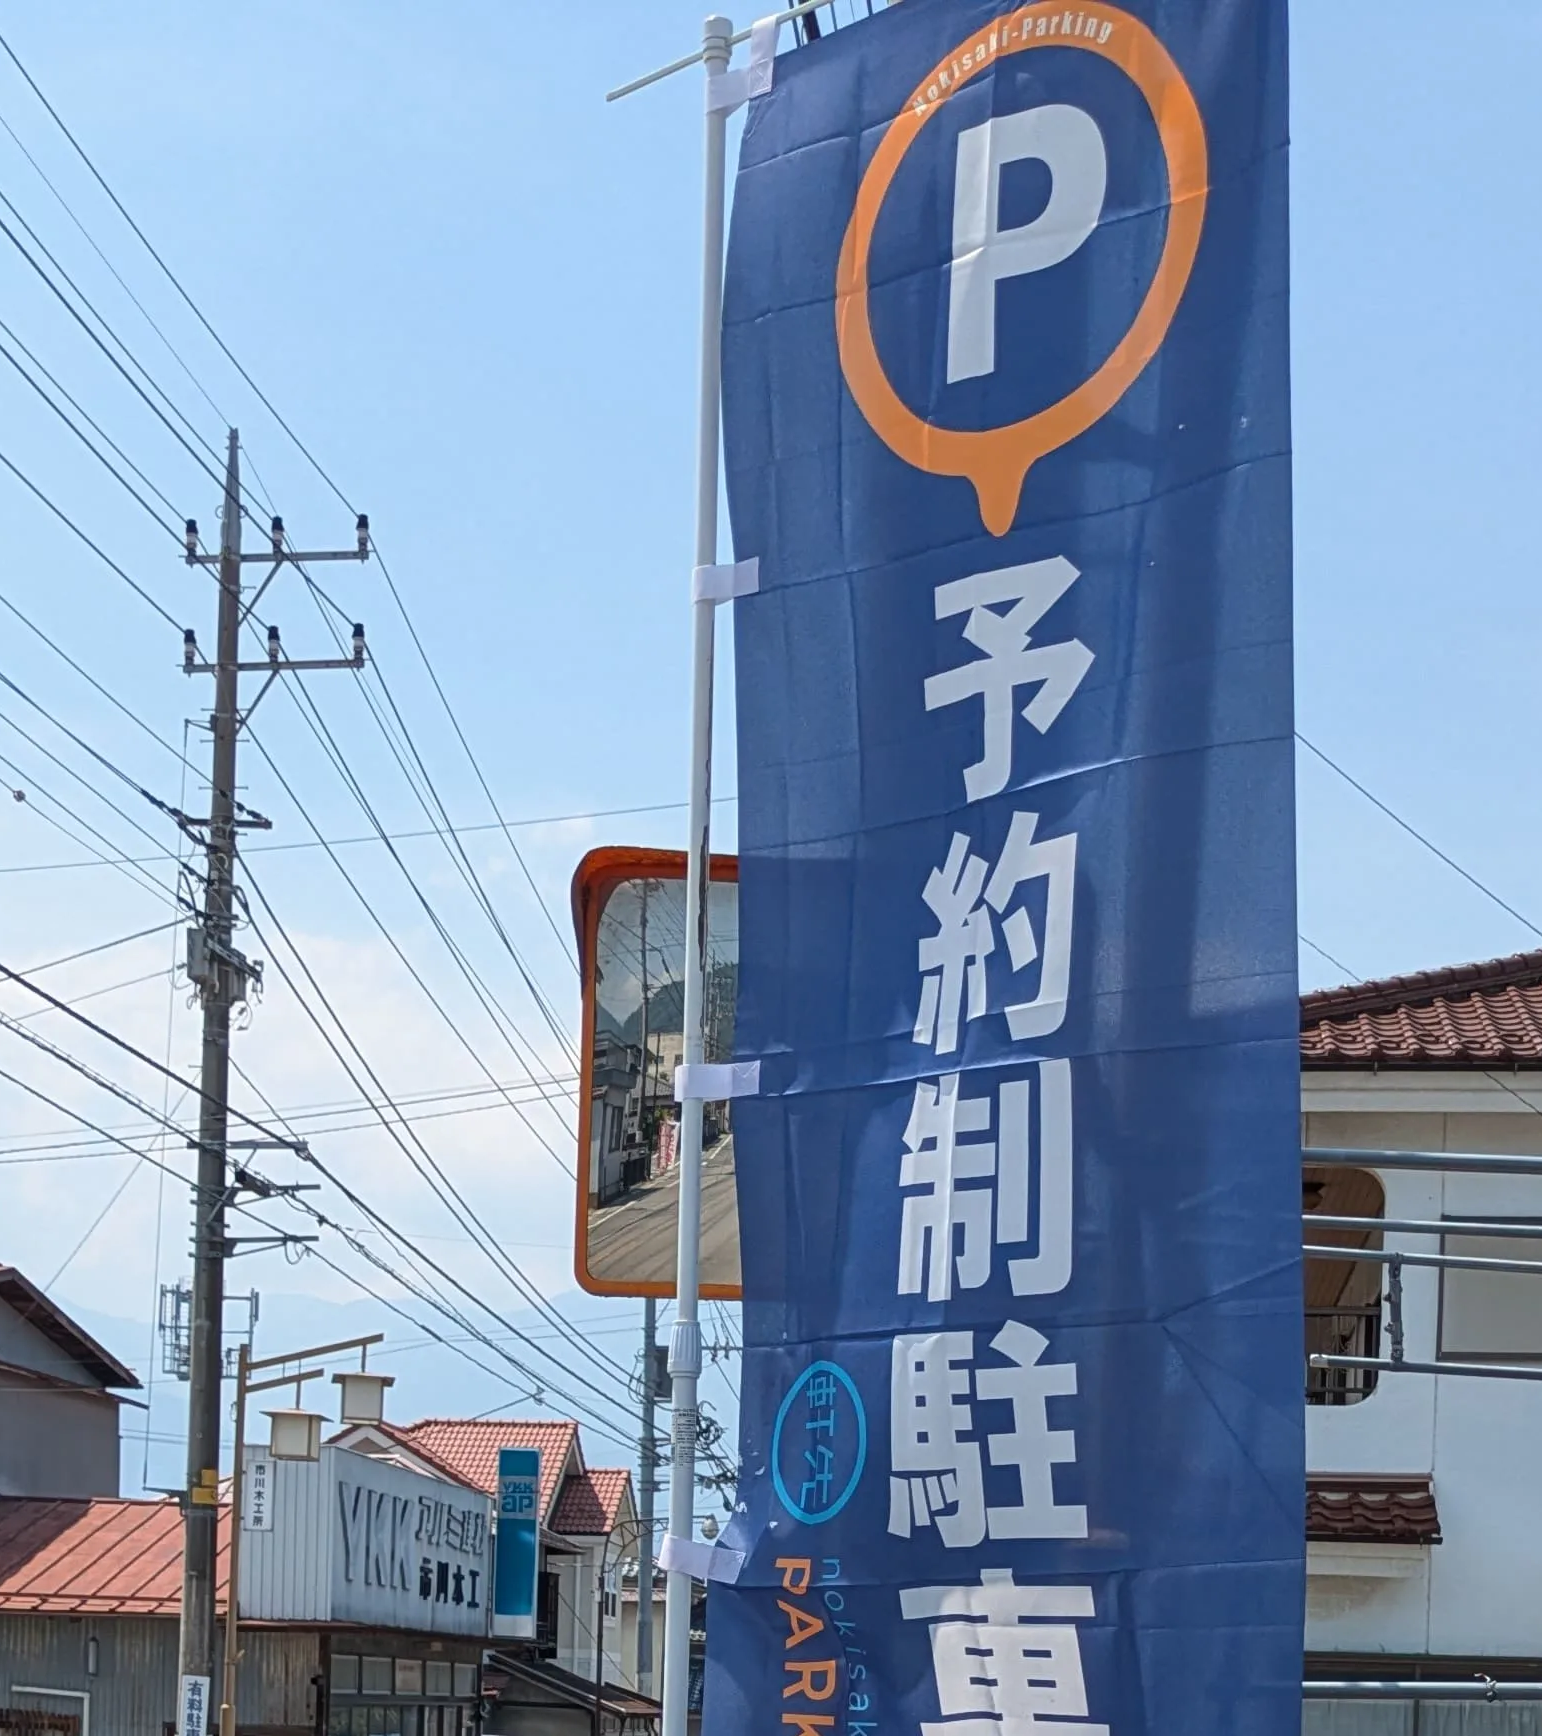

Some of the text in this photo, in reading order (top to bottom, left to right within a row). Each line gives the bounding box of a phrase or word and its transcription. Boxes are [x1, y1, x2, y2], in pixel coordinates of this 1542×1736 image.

[913, 11, 1114, 116] Nokisaki-Parking
[947, 104, 1107, 384] P
[252, 1464, 266, 1528] 市川木工所
[503, 1481, 534, 1494] YKK
[338, 1480, 413, 1592] YKK
[419, 1556, 481, 1609] 市川木工
